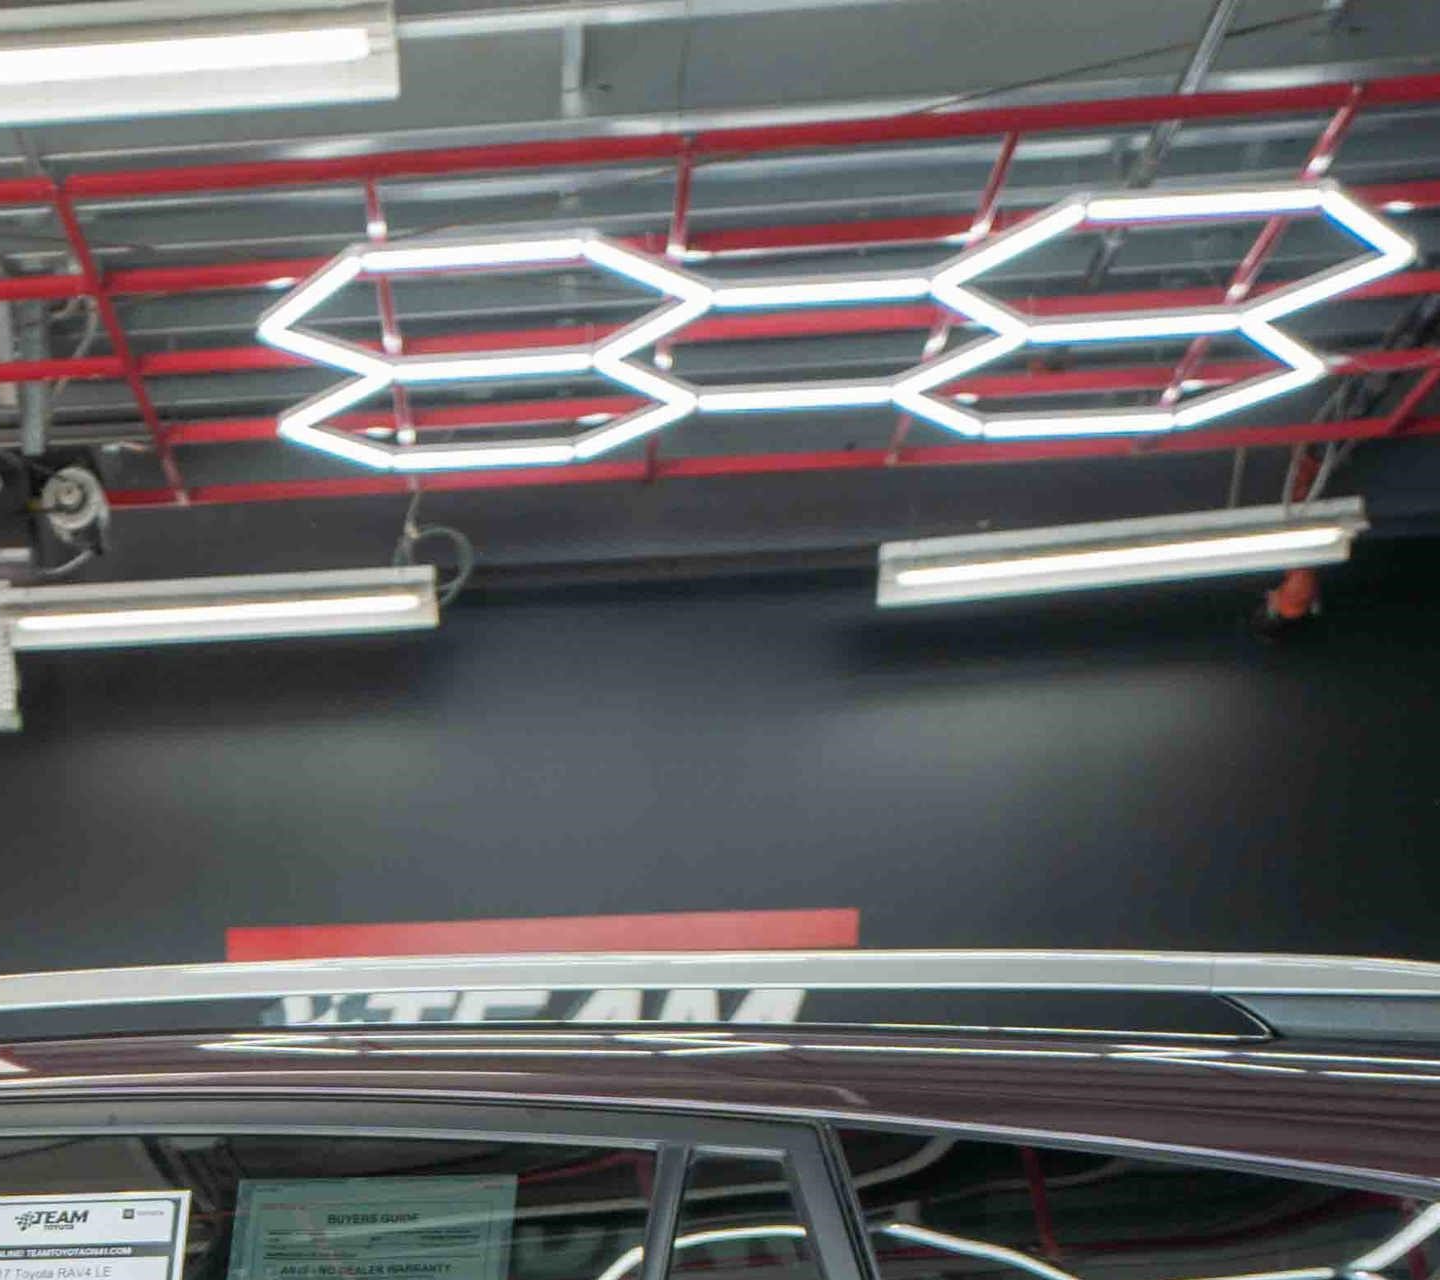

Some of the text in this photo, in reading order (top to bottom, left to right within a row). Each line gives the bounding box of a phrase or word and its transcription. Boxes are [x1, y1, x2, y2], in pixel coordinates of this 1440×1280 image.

[32, 1209, 90, 1225] TEAM
[57, 1266, 92, 1279] RAV4
[95, 1265, 113, 1278] LE
